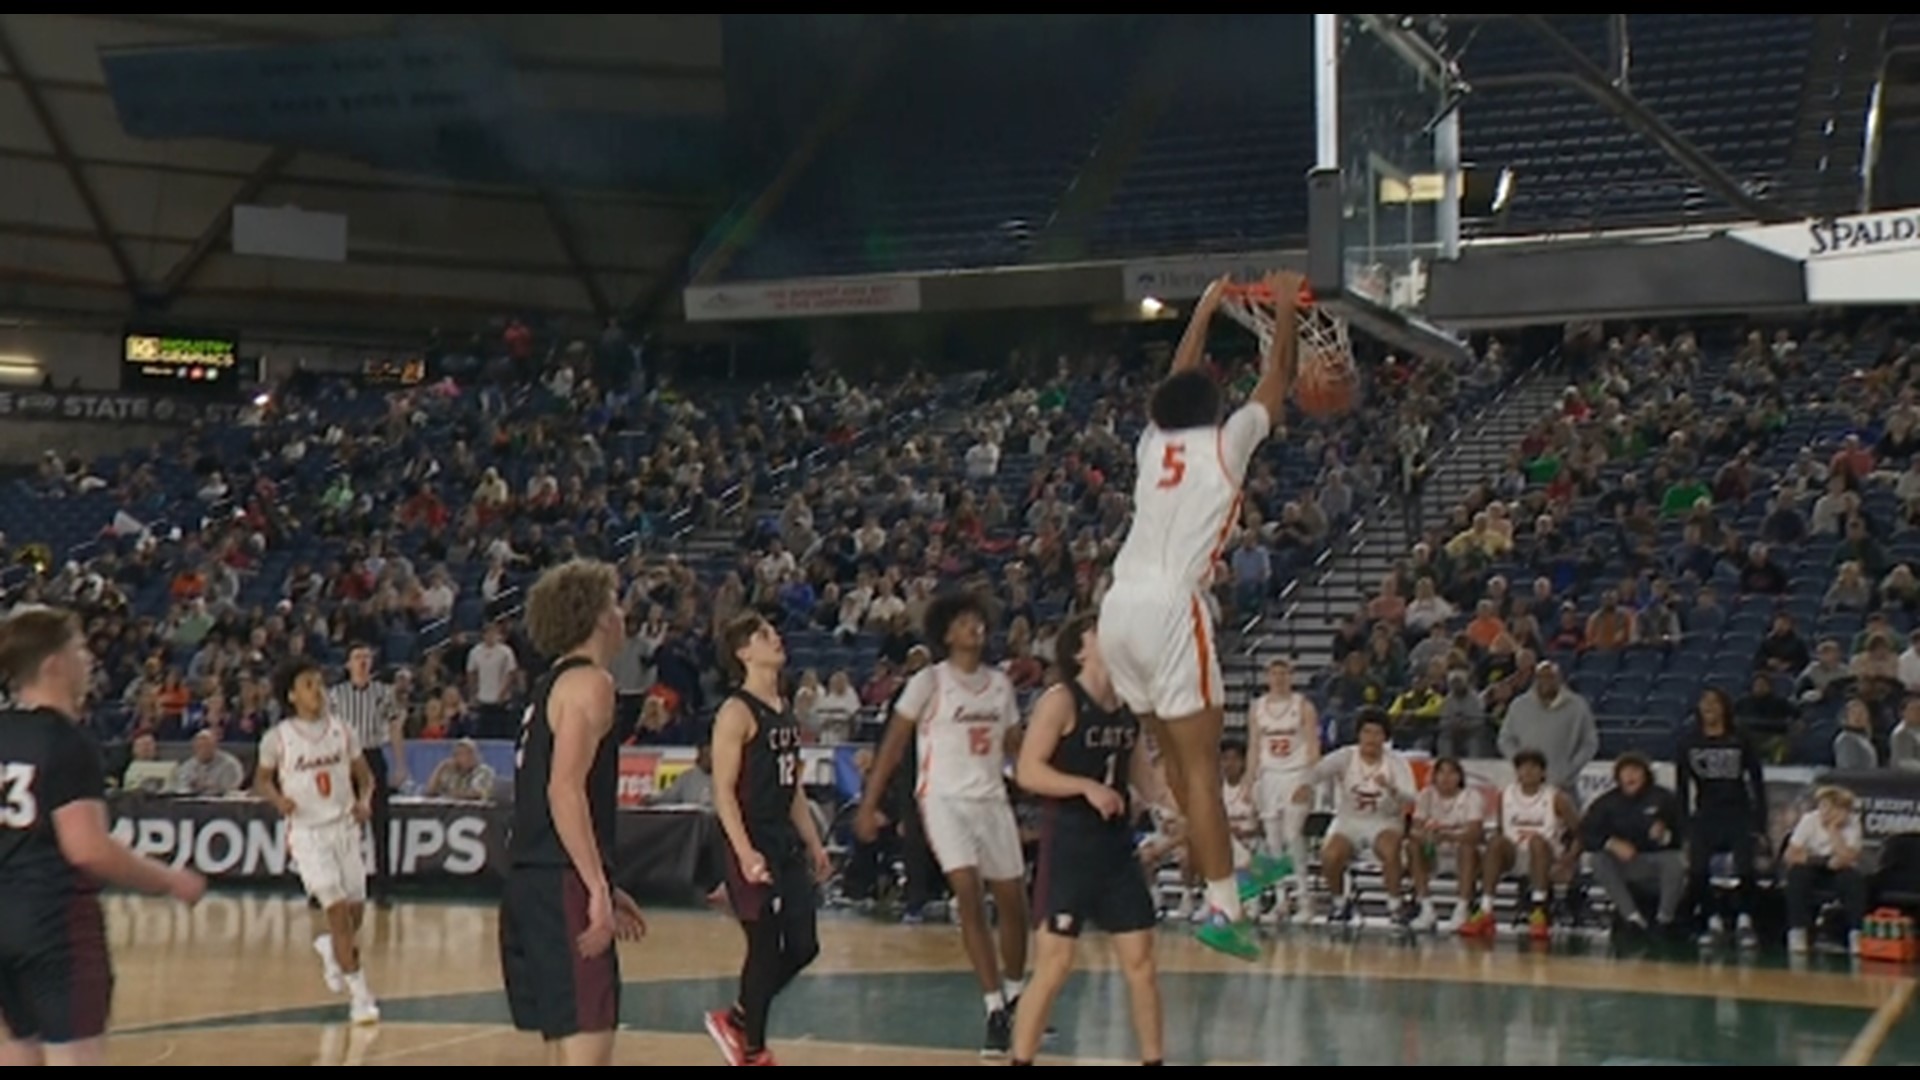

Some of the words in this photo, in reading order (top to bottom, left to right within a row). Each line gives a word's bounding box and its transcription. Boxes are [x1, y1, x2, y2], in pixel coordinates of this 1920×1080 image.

[1809, 216, 1920, 254] SPALD
[64, 396, 149, 420] STATE
[1156, 444, 1186, 490] 5
[968, 726, 992, 757] 15
[1085, 725, 1136, 749] CATS
[315, 770, 332, 799] 0
[777, 753, 795, 786] 12
[1104, 752, 1118, 786] 1
[0, 761, 39, 829] 3
[107, 817, 488, 875] PIONIPS
